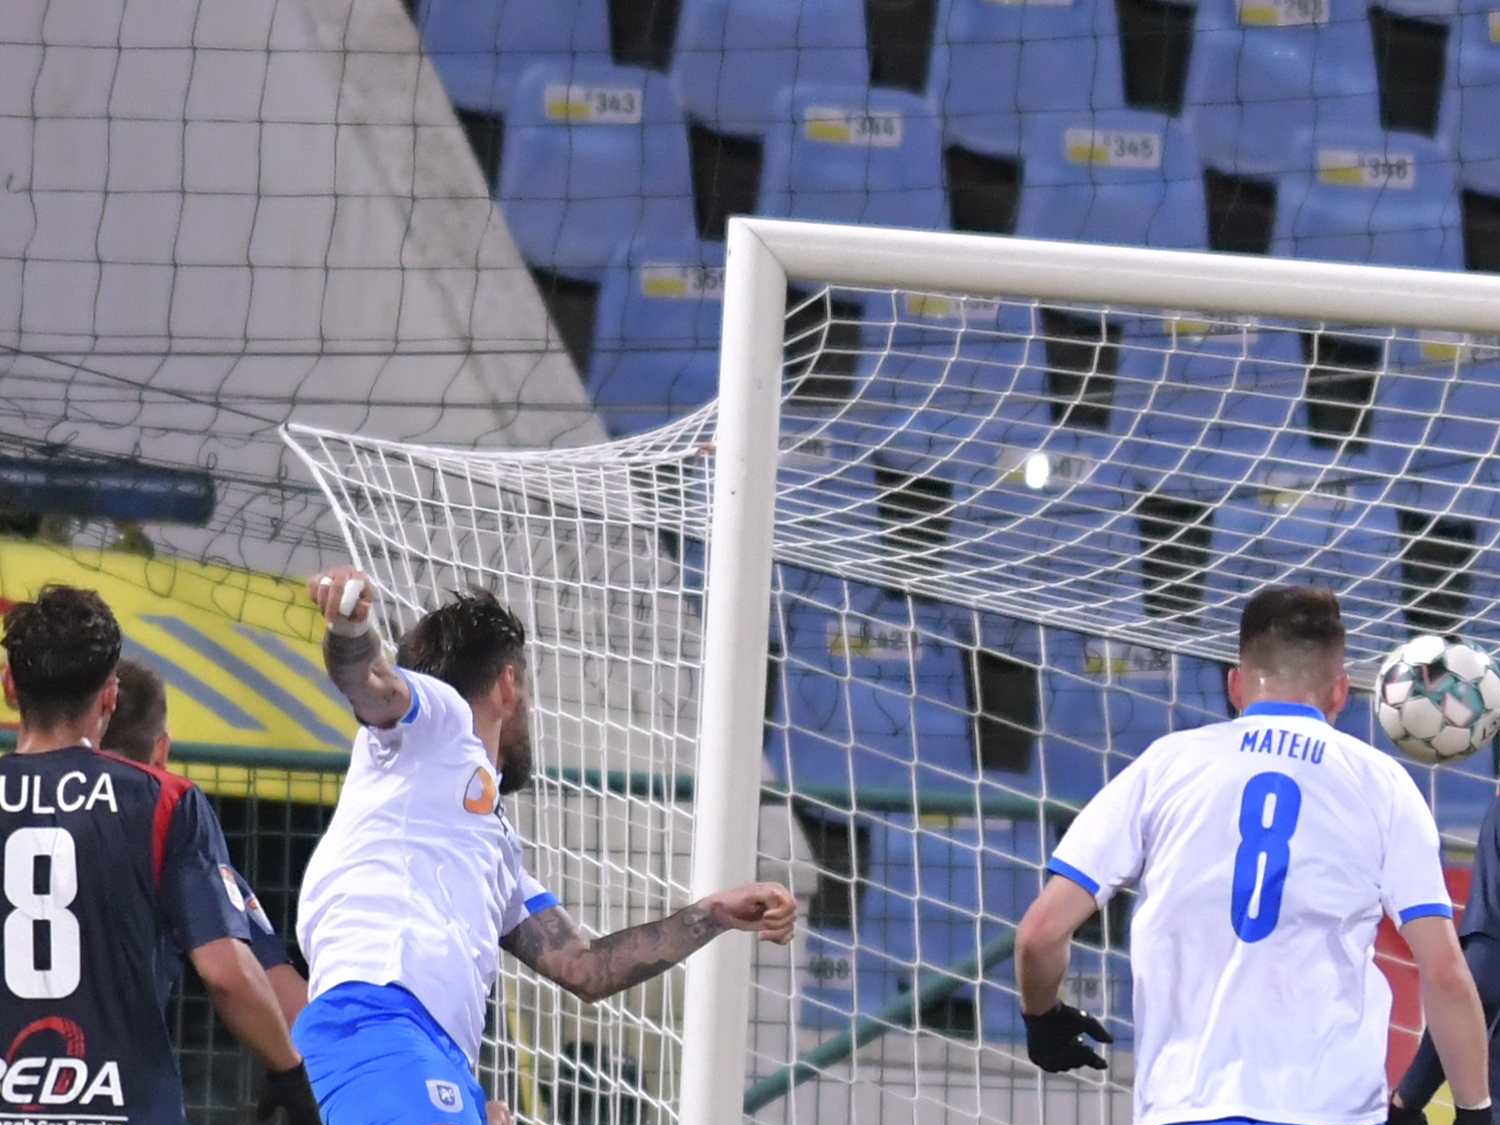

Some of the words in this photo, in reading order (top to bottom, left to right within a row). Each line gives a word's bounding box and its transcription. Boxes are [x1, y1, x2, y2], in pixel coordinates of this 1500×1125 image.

[596, 93, 636, 116] 343
[1113, 136, 1155, 159] 345
[1240, 729, 1326, 765] MATEIU
[1230, 771, 1302, 943] 8
[4, 826, 82, 999] 8
[0, 1056, 125, 1106] EDA
